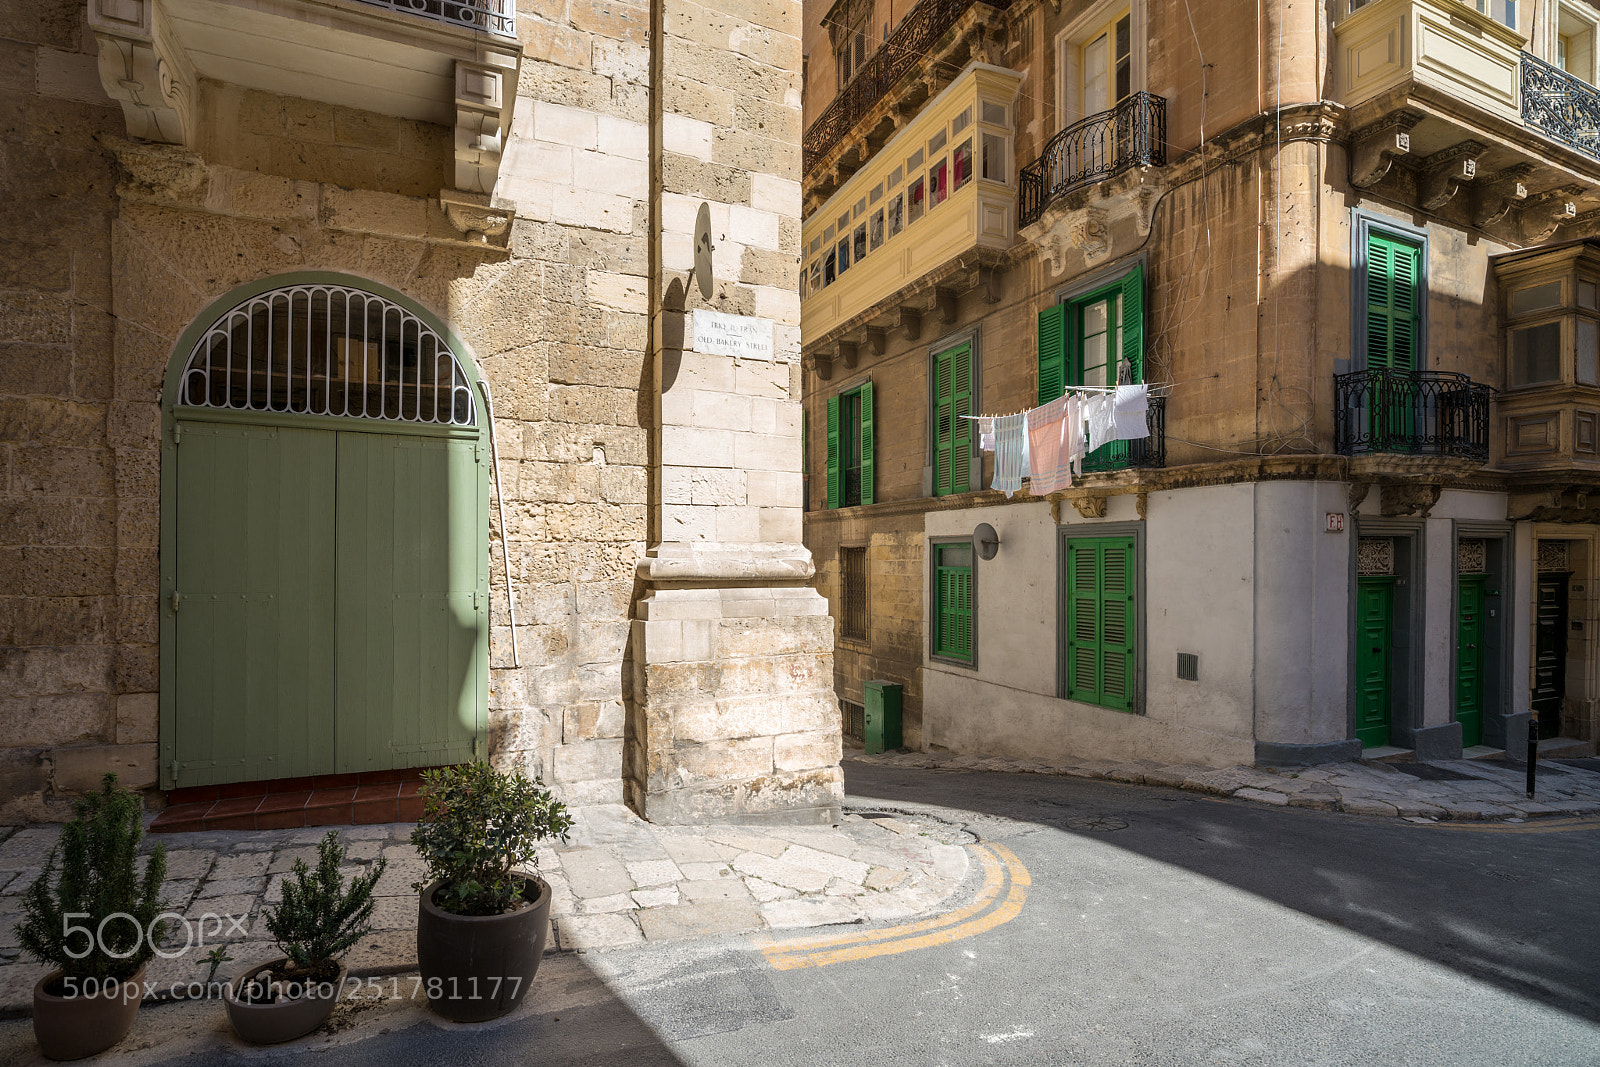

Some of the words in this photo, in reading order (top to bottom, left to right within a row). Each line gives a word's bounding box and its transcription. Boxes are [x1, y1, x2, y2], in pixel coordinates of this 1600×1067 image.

[697, 335, 713, 344] OLD
[716, 338, 742, 348] BAKERY
[746, 342, 768, 351] STREET
